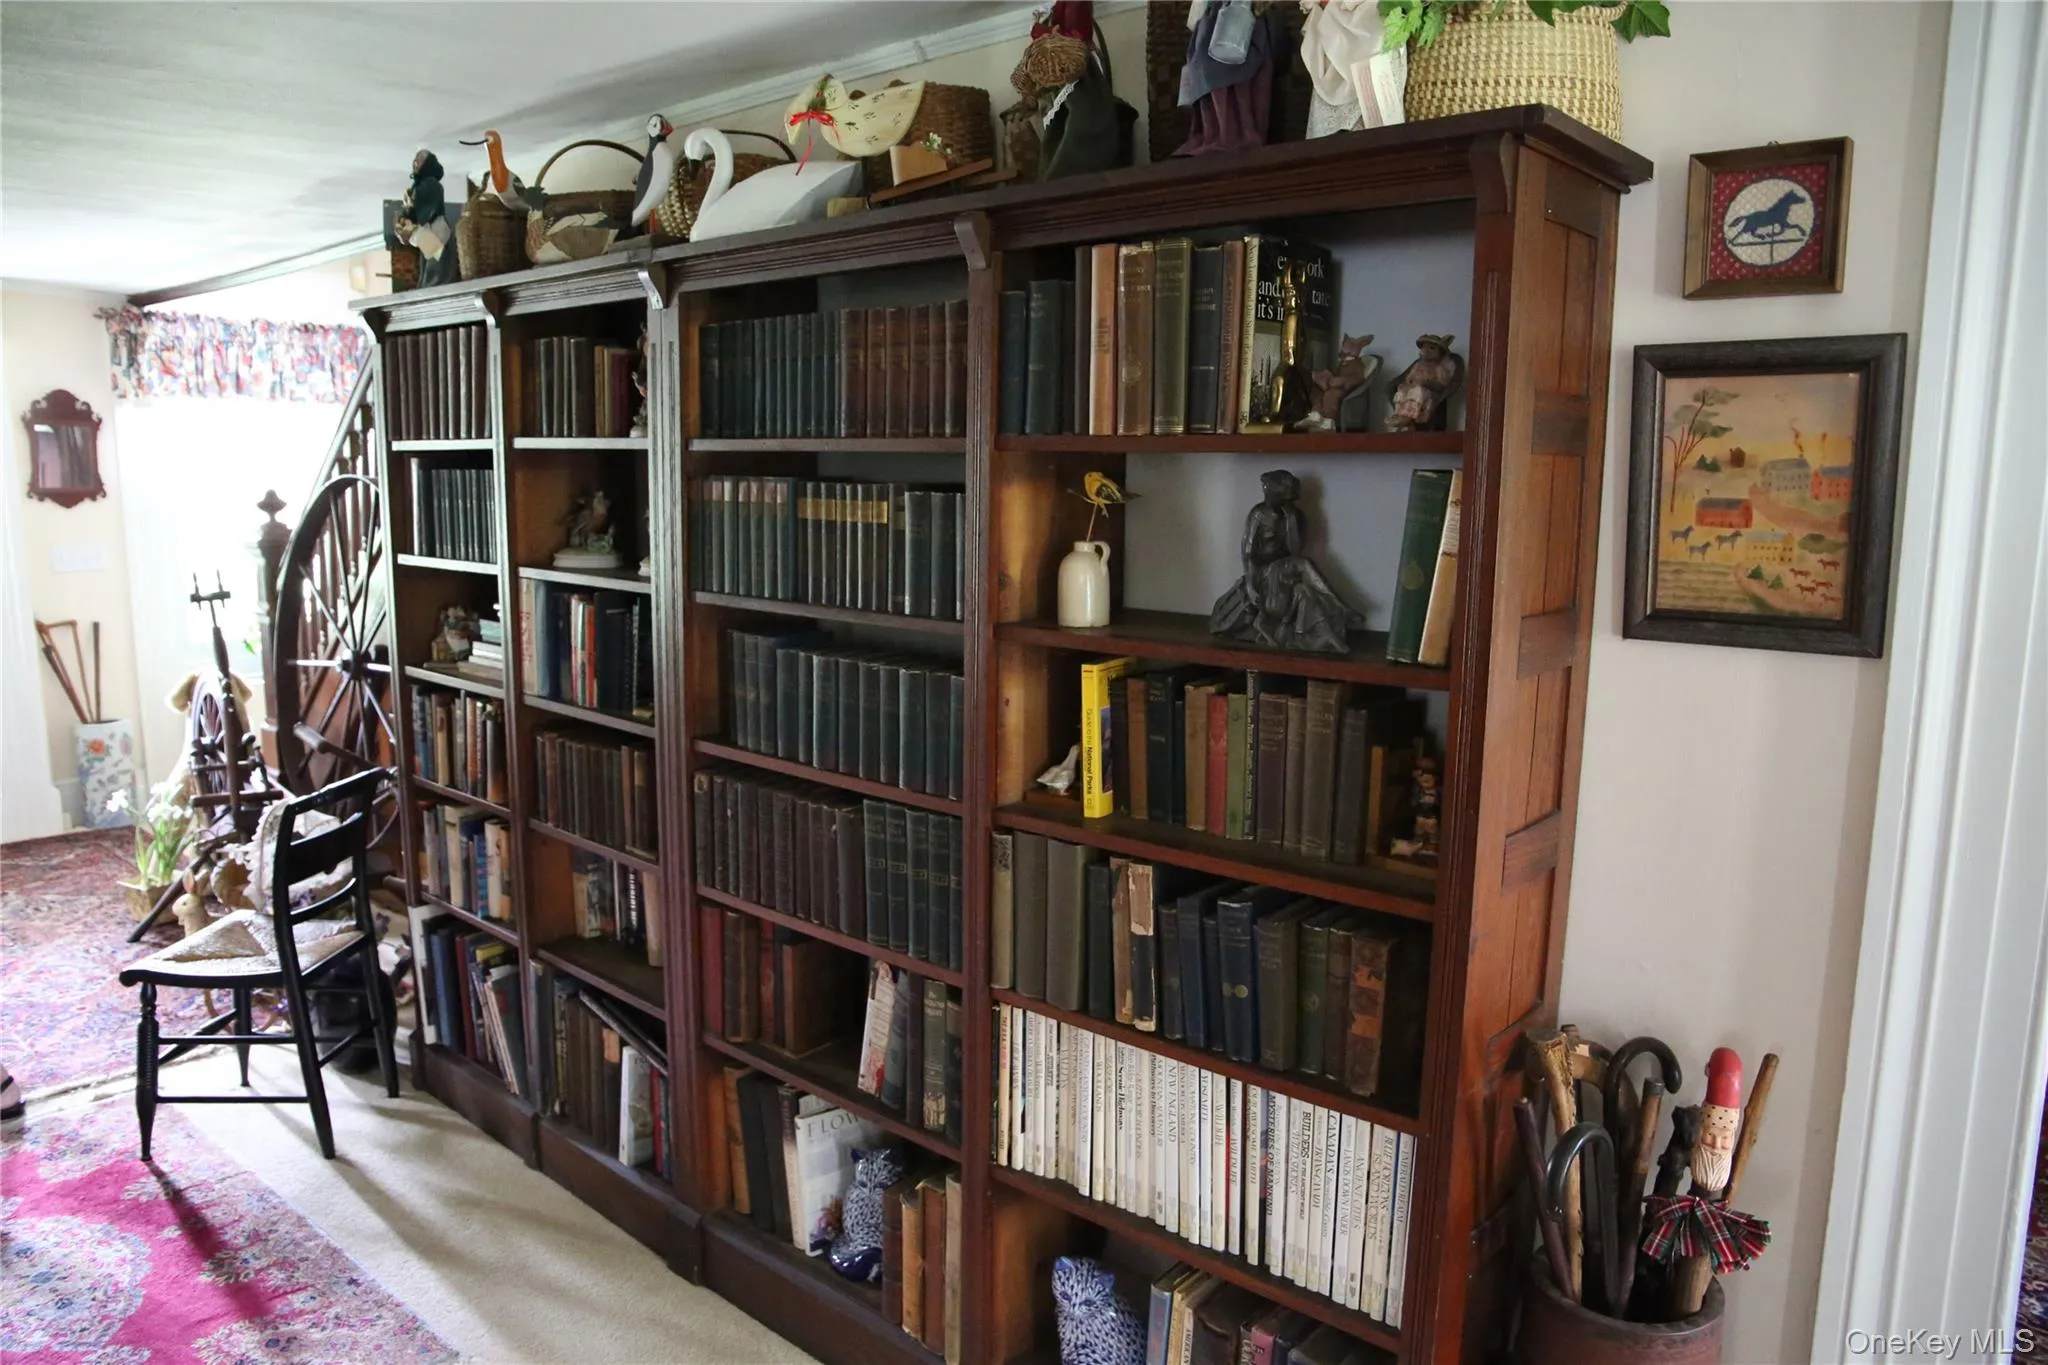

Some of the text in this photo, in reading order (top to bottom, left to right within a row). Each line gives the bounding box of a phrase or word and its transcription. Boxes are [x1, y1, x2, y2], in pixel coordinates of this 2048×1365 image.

[1307, 257, 1324, 278] ork
[1258, 280, 1281, 298] and
[1257, 296, 1274, 320] it's
[808, 1112, 858, 1138] FLOW
[1168, 1091, 1176, 1142] ENGLAND
[1302, 1112, 1311, 1158] BUILDERS
[1327, 1114, 1338, 1174] CANADA'S
